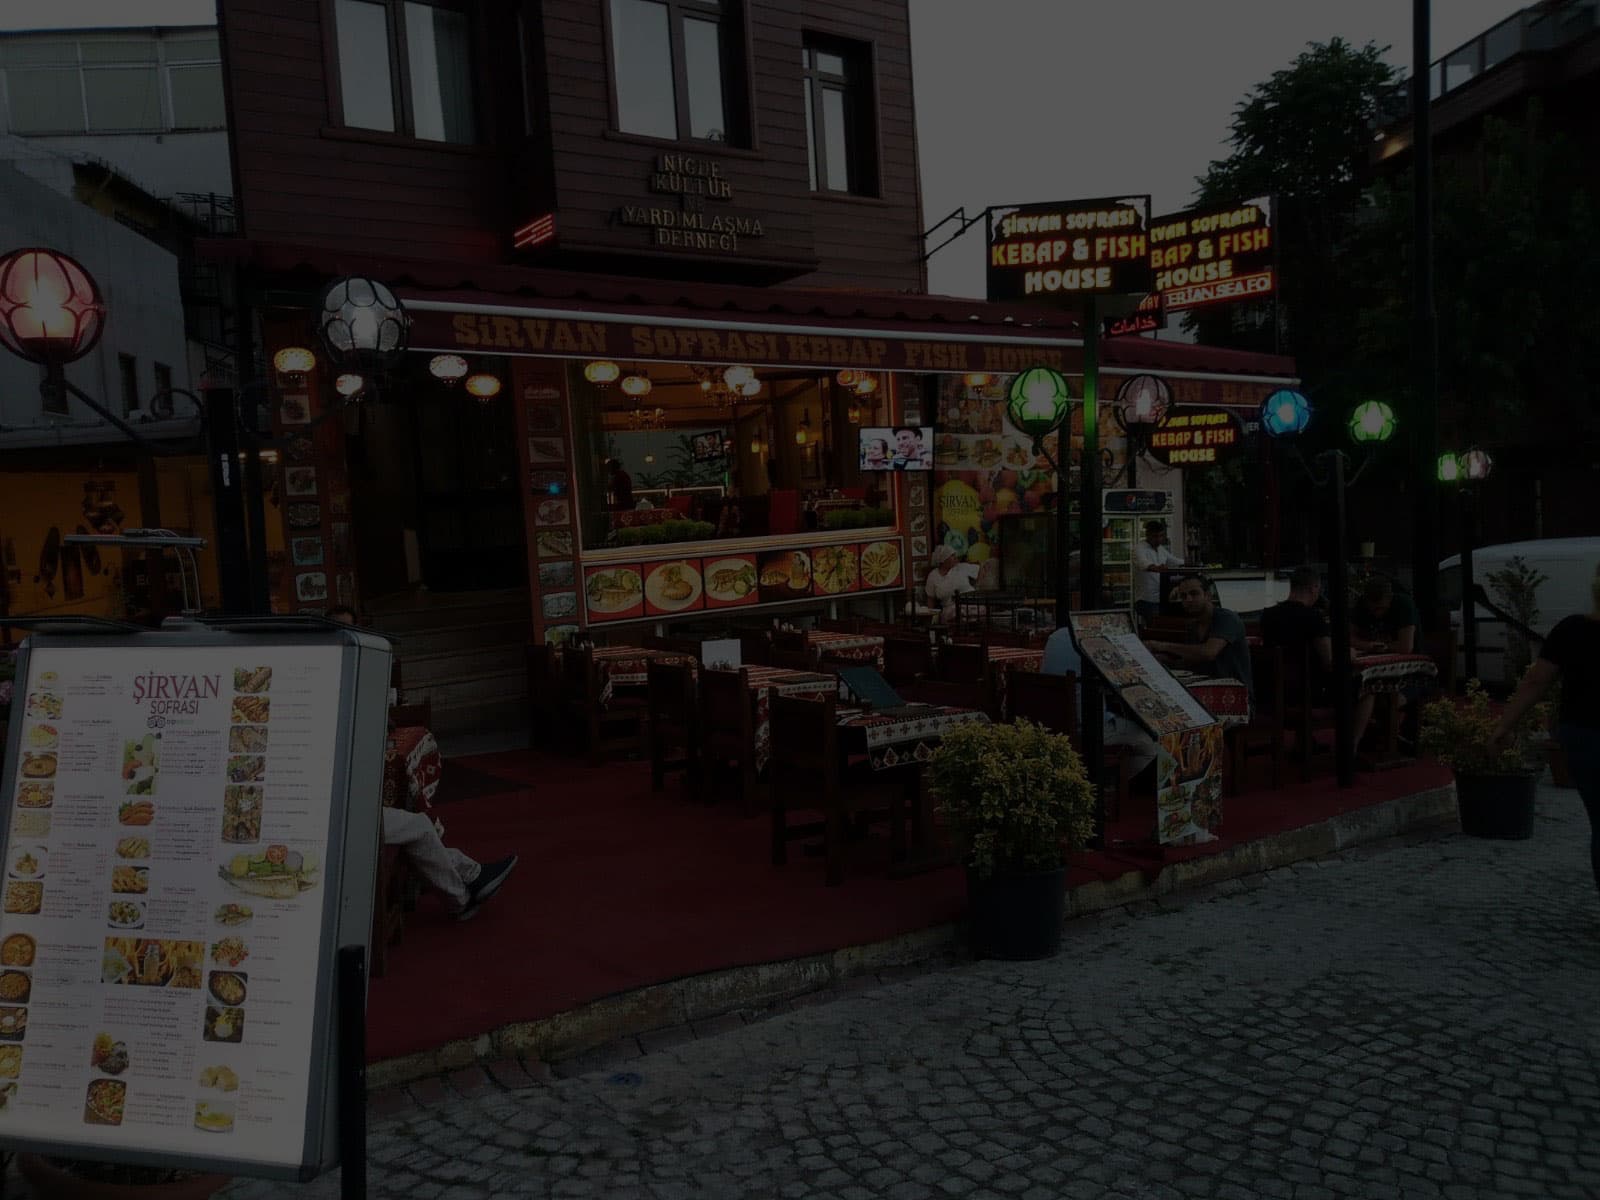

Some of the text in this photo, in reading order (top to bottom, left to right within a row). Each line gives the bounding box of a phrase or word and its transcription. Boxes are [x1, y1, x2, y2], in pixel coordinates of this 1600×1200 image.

[992, 235, 1147, 267] KEBAP & FISH
[1198, 239, 1214, 260] &
[1219, 227, 1270, 257] FISH
[1024, 266, 1112, 295] HOUSE
[1155, 258, 1234, 291] HOUSE
[786, 333, 889, 366] KEBAP
[903, 342, 969, 370] FISH
[1152, 431, 1191, 447] KEBAP
[1205, 427, 1234, 445] FISH
[132, 671, 221, 705] ŞİRVAN
[150, 700, 199, 715] SOFRASI
